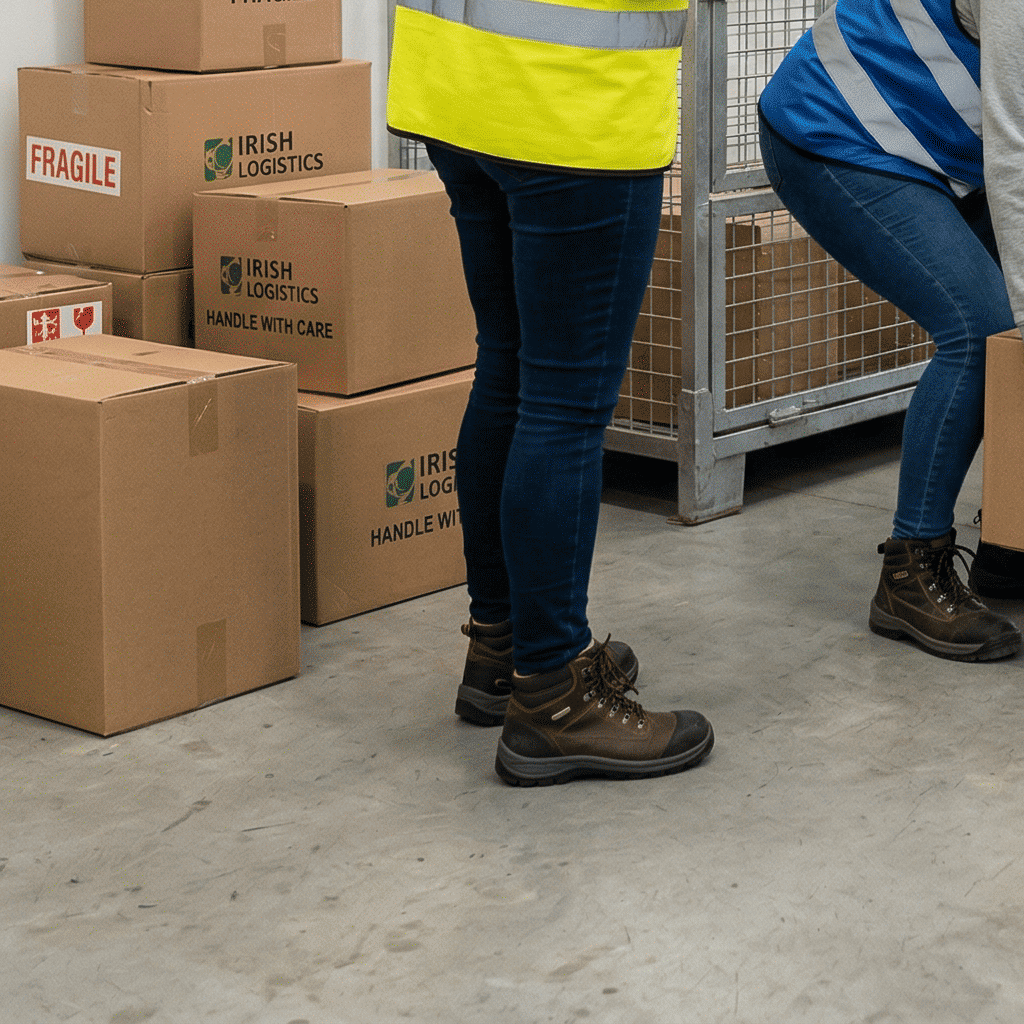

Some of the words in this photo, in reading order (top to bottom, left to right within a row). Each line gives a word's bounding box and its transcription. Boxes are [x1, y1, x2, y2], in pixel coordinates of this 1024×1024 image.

[238, 131, 294, 155] IRISH
[31, 143, 116, 189] FRAGILE
[238, 153, 324, 178] LOGISTICS
[246, 257, 292, 280] IRISH
[246, 283, 319, 304] LOGISTICS
[206, 309, 258, 331] HANDLE
[260, 315, 293, 334] WITH
[297, 319, 333, 339] CARE
[420, 448, 457, 477] IRIS
[371, 515, 433, 548] HANDLE
[438, 508, 462, 530] WIT
